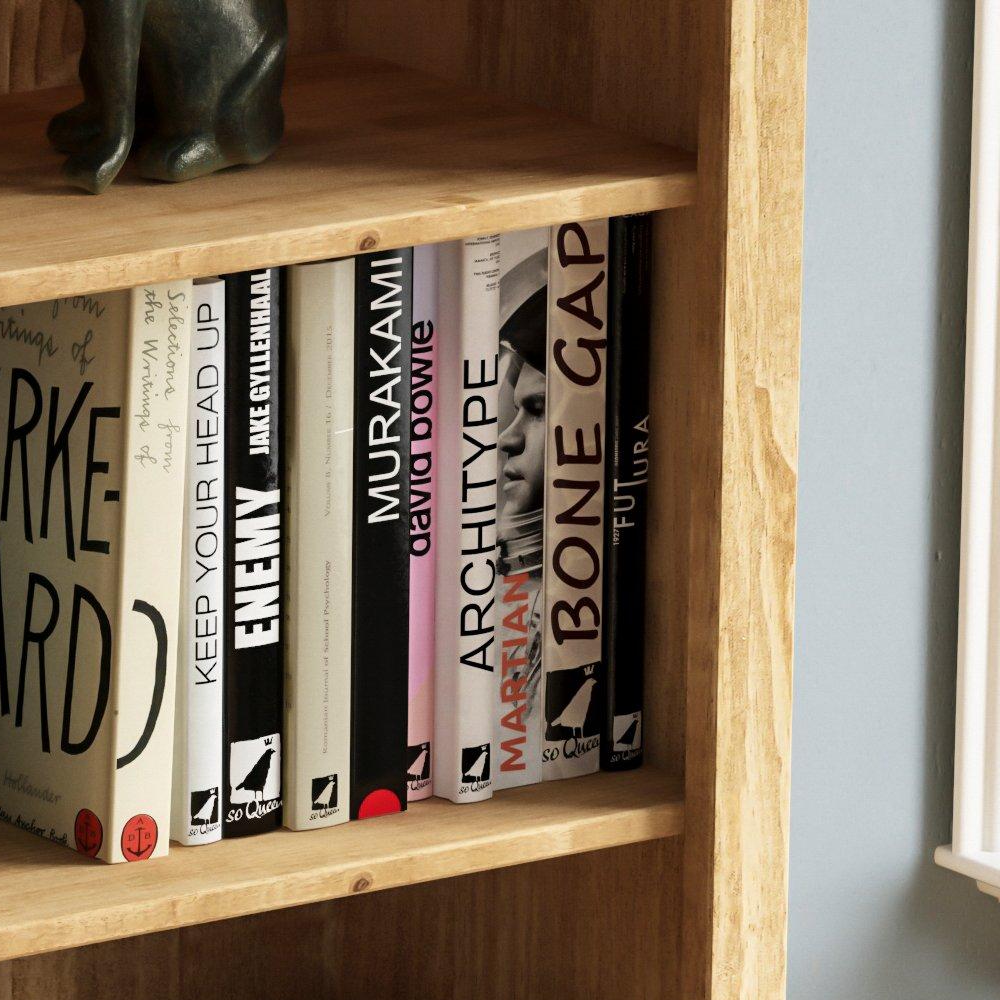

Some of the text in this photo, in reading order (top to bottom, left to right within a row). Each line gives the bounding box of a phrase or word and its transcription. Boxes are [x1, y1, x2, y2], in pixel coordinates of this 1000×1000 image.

[71, 329, 96, 376] of
[133, 289, 163, 470] the Writings of
[157, 289, 186, 475] Selections from
[249, 269, 271, 456] JAKE GYLLENHAAL
[368, 257, 403, 525] MURAKAMI
[551, 222, 607, 646] BONE GAP
[194, 302, 220, 686] KEEP YOUR HEAD UP
[459, 354, 500, 673] ARCHITYPE
[613, 414, 650, 529] FUTURA
[234, 485, 281, 650] ENEMY
[323, 559, 332, 615] Psychology
[499, 572, 530, 772] MARTIAN
[542, 737, 601, 763] so Queen
[225, 798, 283, 824] so Queen
